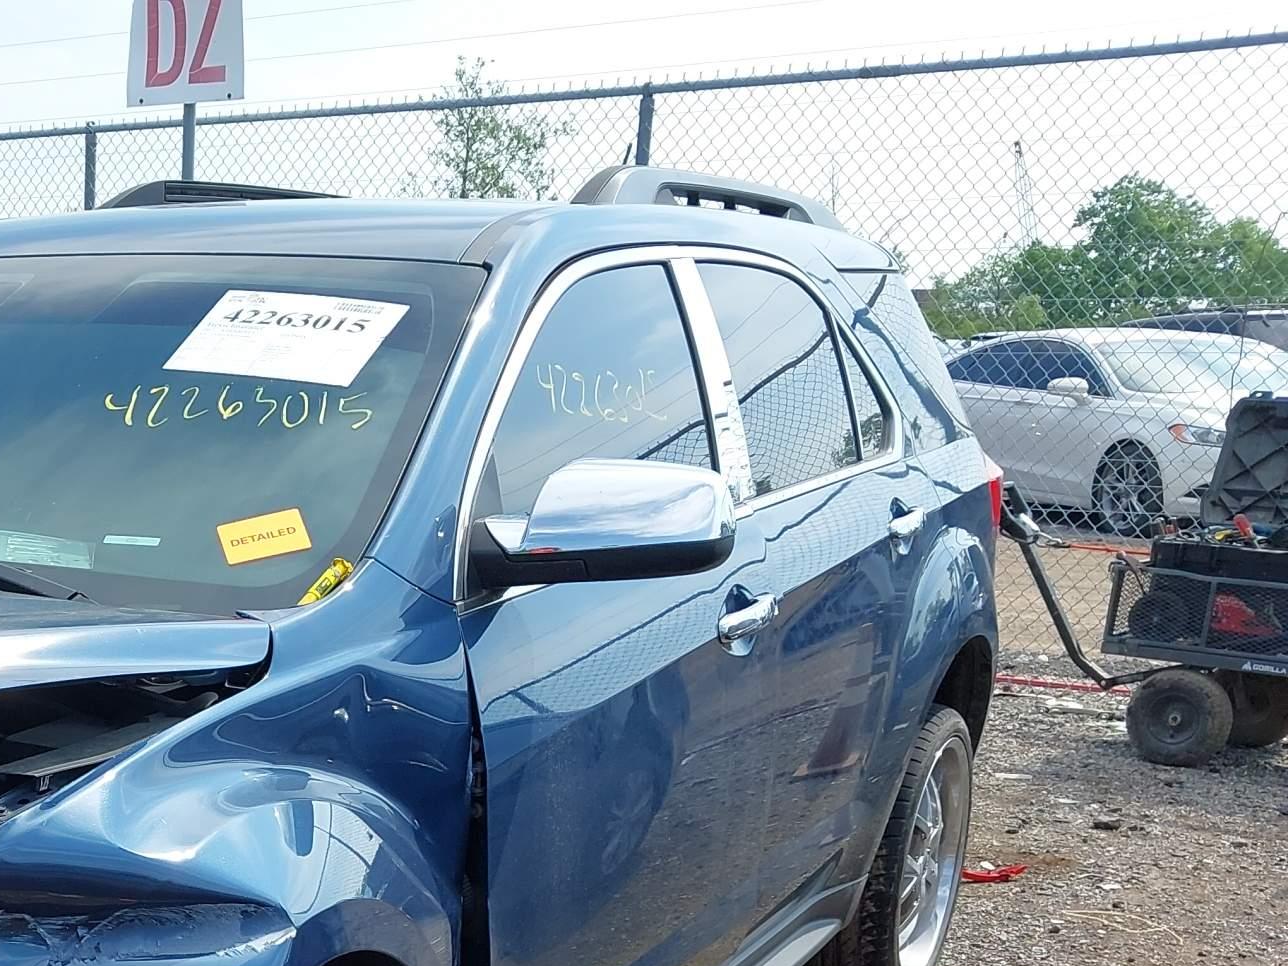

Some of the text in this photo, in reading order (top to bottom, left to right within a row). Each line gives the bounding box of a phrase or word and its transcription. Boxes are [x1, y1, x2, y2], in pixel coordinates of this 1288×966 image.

[223, 308, 371, 334] 42263015
[105, 384, 373, 430] 42263015
[230, 526, 297, 548] DETAILED
